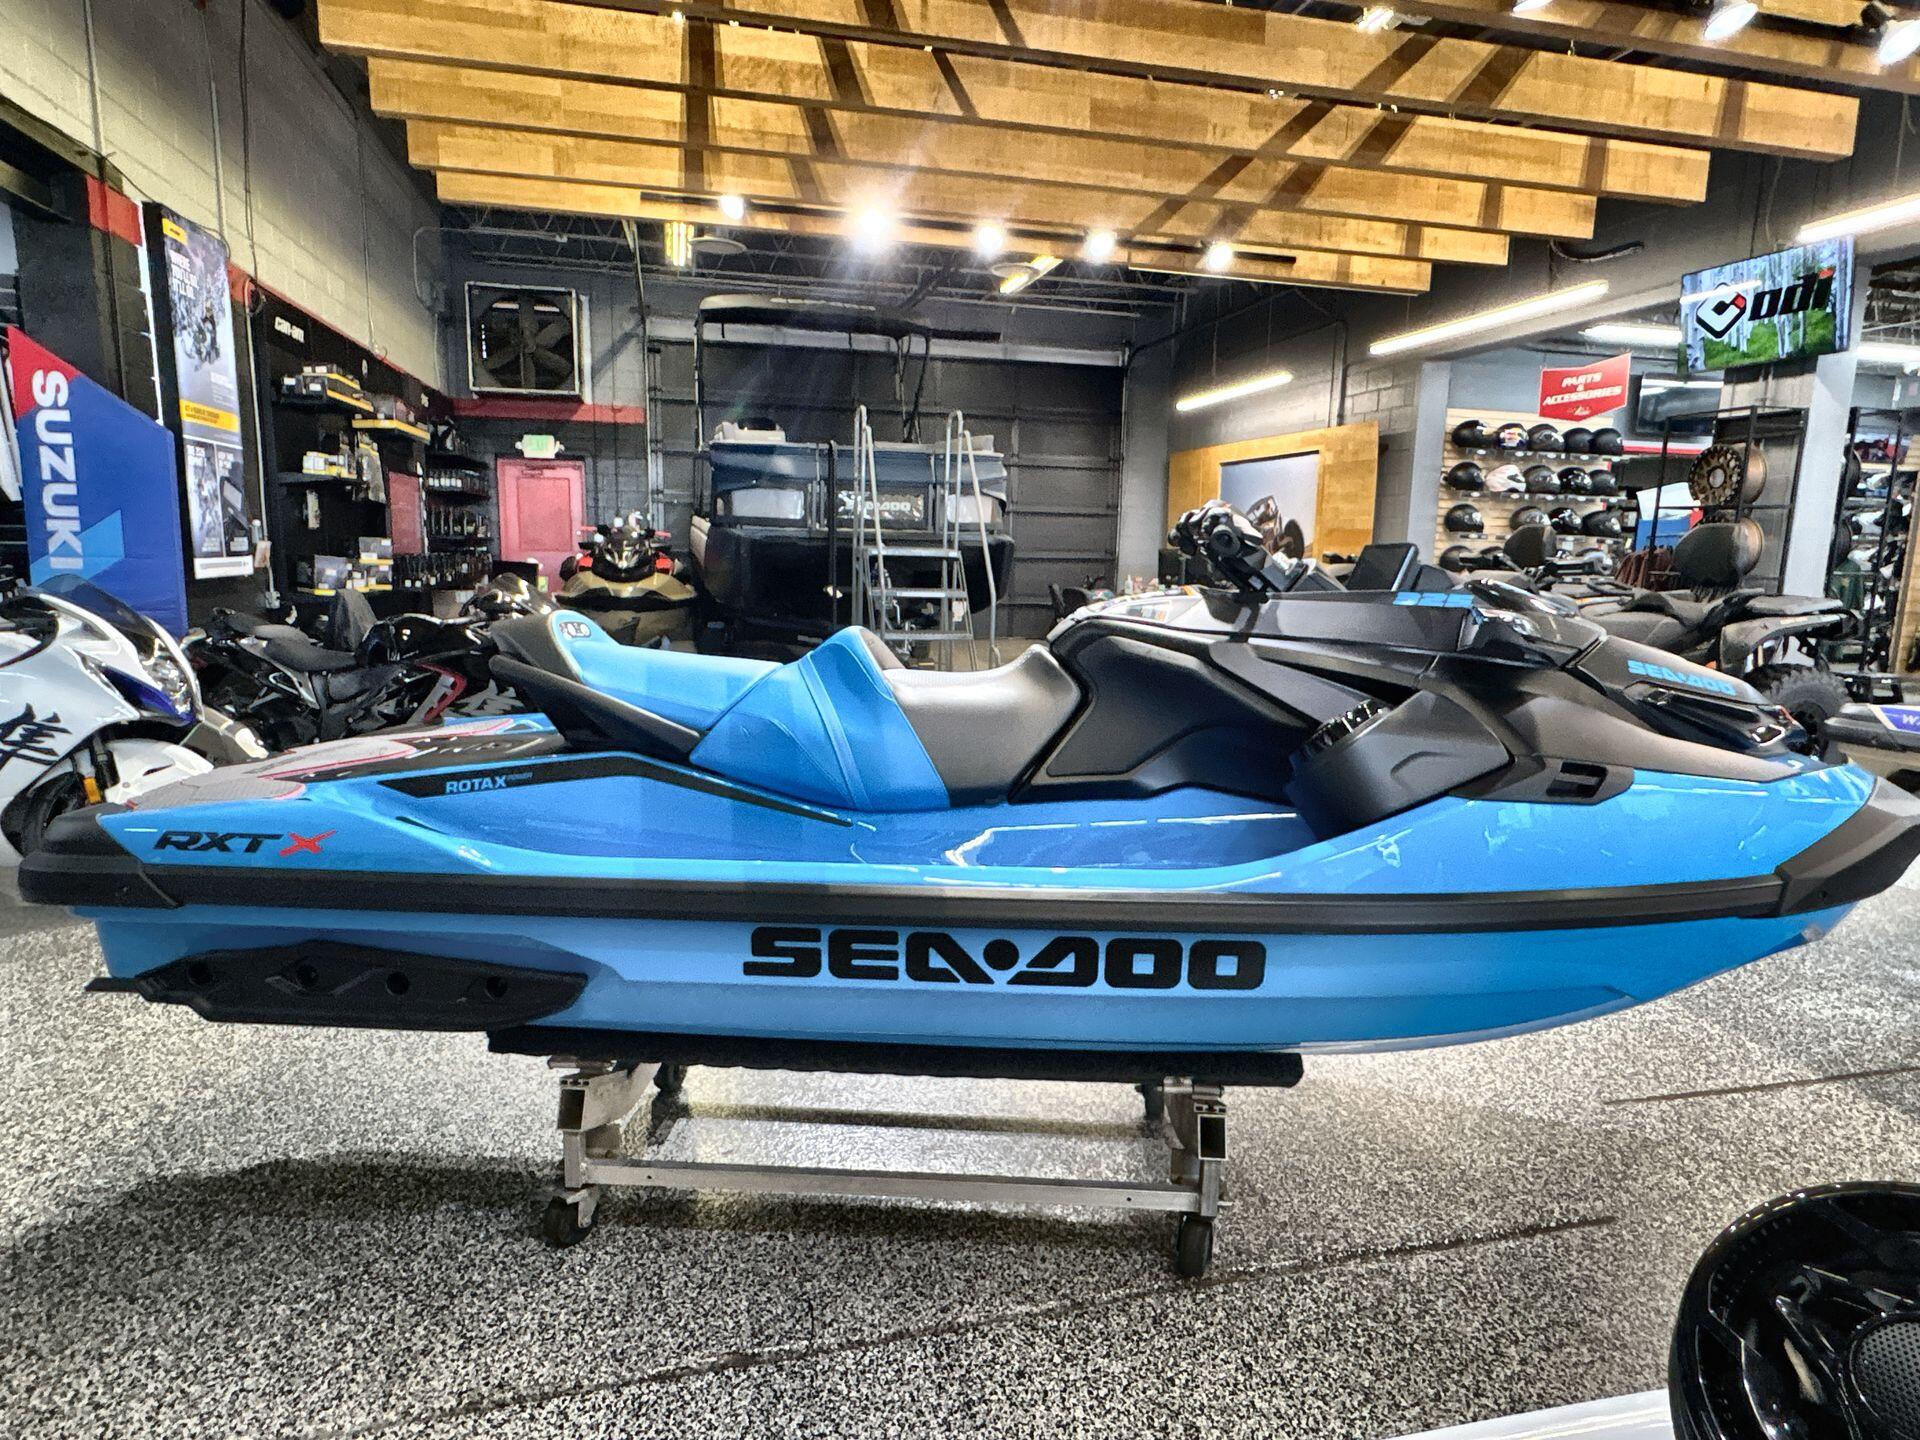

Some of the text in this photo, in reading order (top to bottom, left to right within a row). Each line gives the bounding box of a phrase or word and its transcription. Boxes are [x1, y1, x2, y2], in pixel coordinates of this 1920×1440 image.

[1748, 266, 1836, 321] odi
[1561, 372, 1603, 388] PARTS
[1542, 385, 1624, 406] ACCESSORIES
[31, 369, 84, 569] SUZUKI
[445, 774, 508, 794] ROTAX
[153, 828, 337, 857] RXT X
